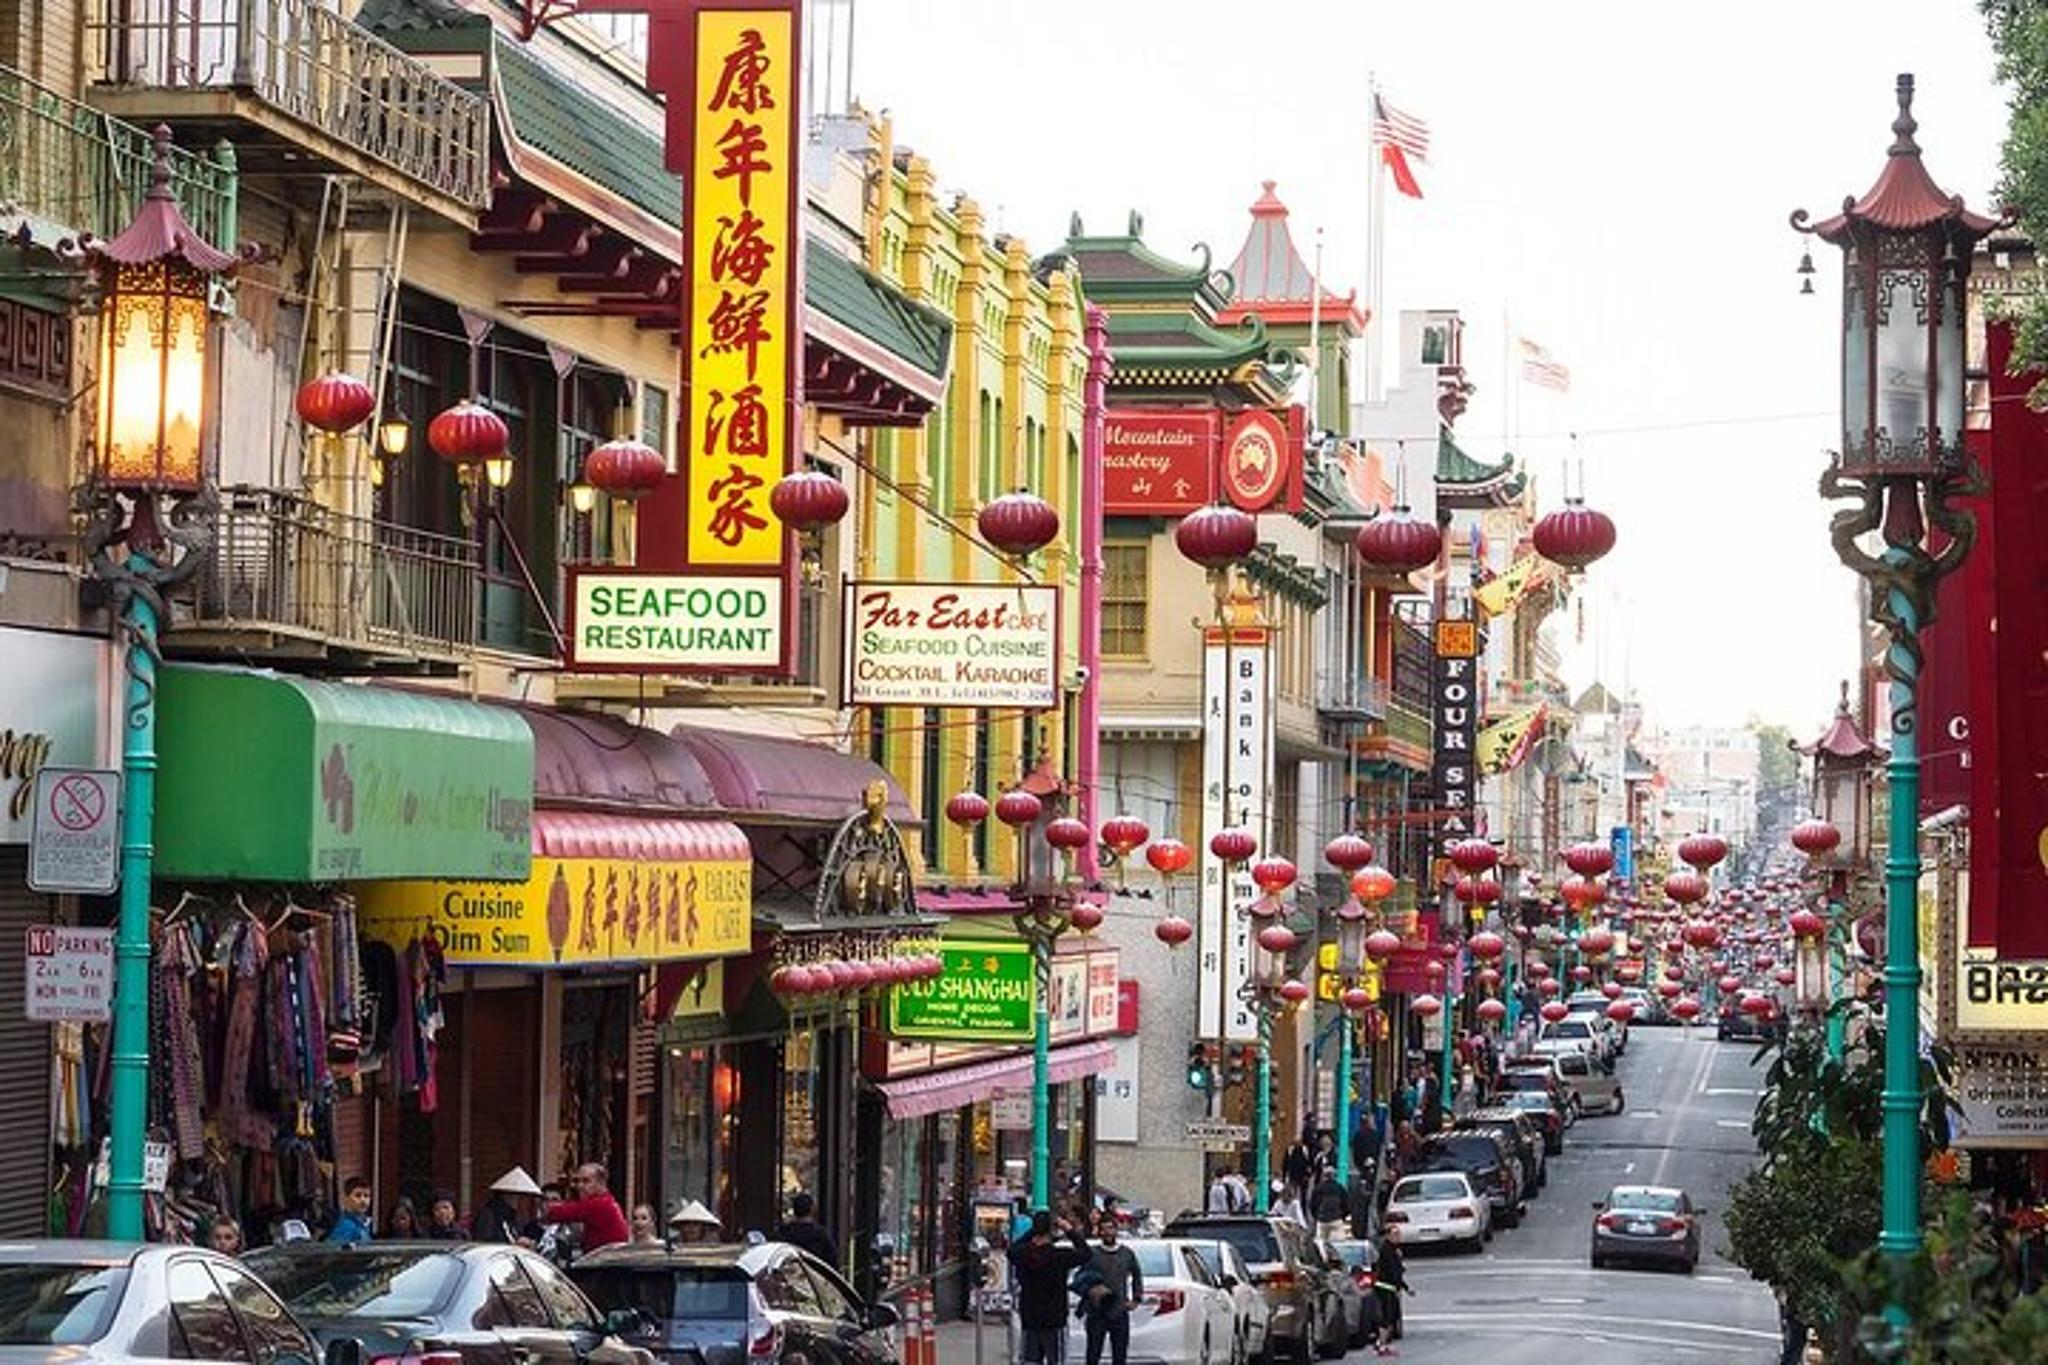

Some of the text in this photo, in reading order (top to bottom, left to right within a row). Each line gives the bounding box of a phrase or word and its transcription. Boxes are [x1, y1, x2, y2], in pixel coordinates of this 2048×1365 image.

[700, 29, 775, 548] 康年海鮮酒家
[590, 586, 767, 618] SEAFOOD
[861, 592, 920, 629] Far
[927, 594, 1008, 629] East
[585, 625, 772, 651] RESTAURANT
[863, 631, 1047, 657] SEAFOOD CUISINE
[858, 659, 1048, 685] COCKTAIL KARAOKE
[1239, 660, 1253, 757] Bank
[1445, 660, 1467, 749] FOUR
[1239, 783, 1252, 826] of
[444, 890, 524, 919] Cuisine
[29, 930, 54, 955] NO
[491, 926, 529, 953] Sum
[940, 977, 1028, 1001] SHANGHAI
[927, 1002, 1000, 1013] HOME DECOR
